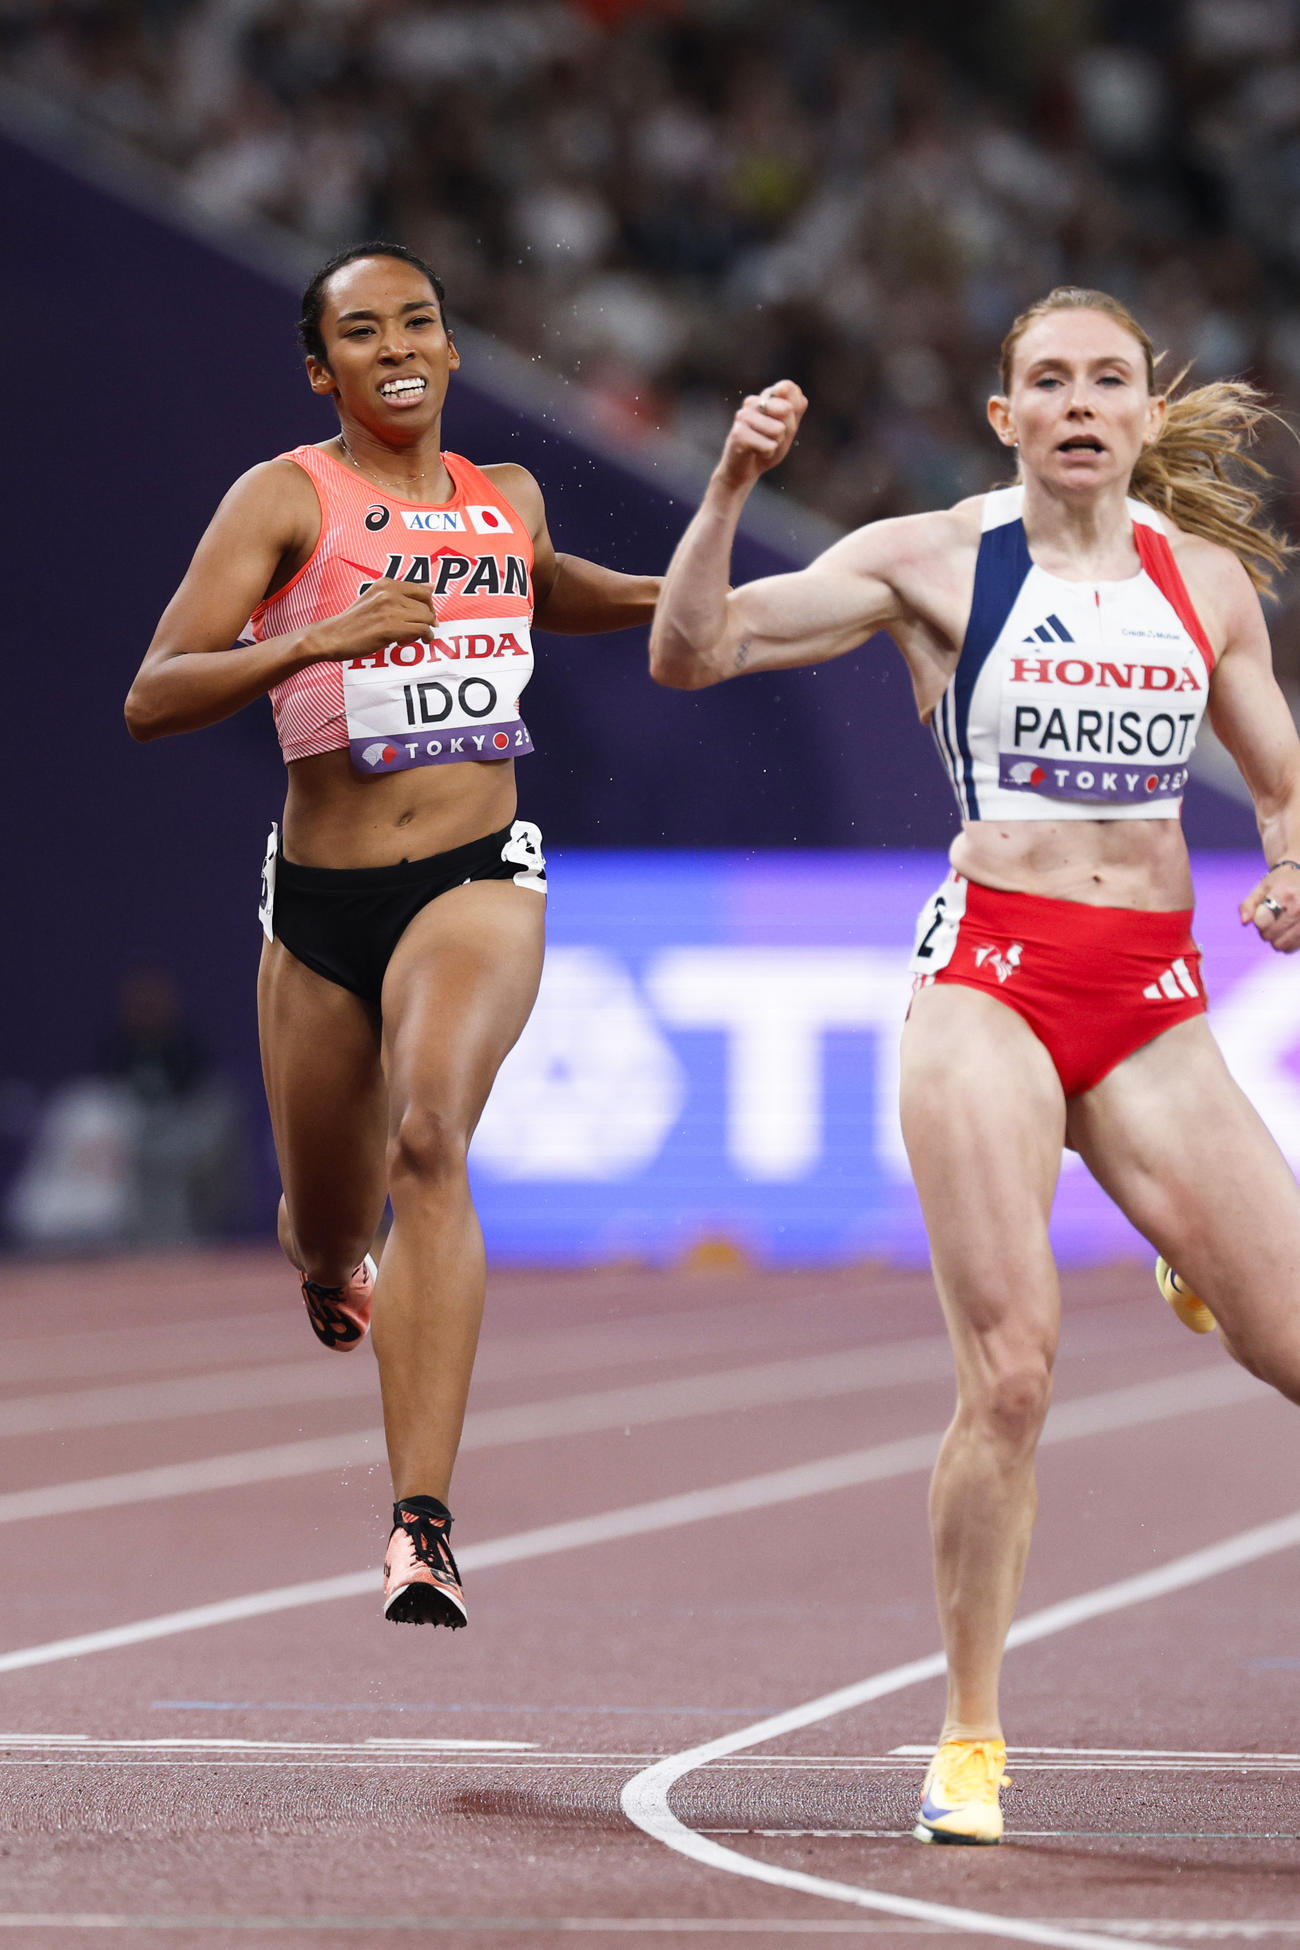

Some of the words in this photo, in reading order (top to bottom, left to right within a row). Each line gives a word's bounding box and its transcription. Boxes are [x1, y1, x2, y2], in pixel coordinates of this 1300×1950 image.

[409, 513, 458, 530] ACN
[359, 554, 529, 598] JAPAN
[1010, 658, 1202, 692] HONDA
[403, 677, 498, 726] IDO
[1014, 706, 1196, 757] PARISOT
[917, 896, 946, 958] 2
